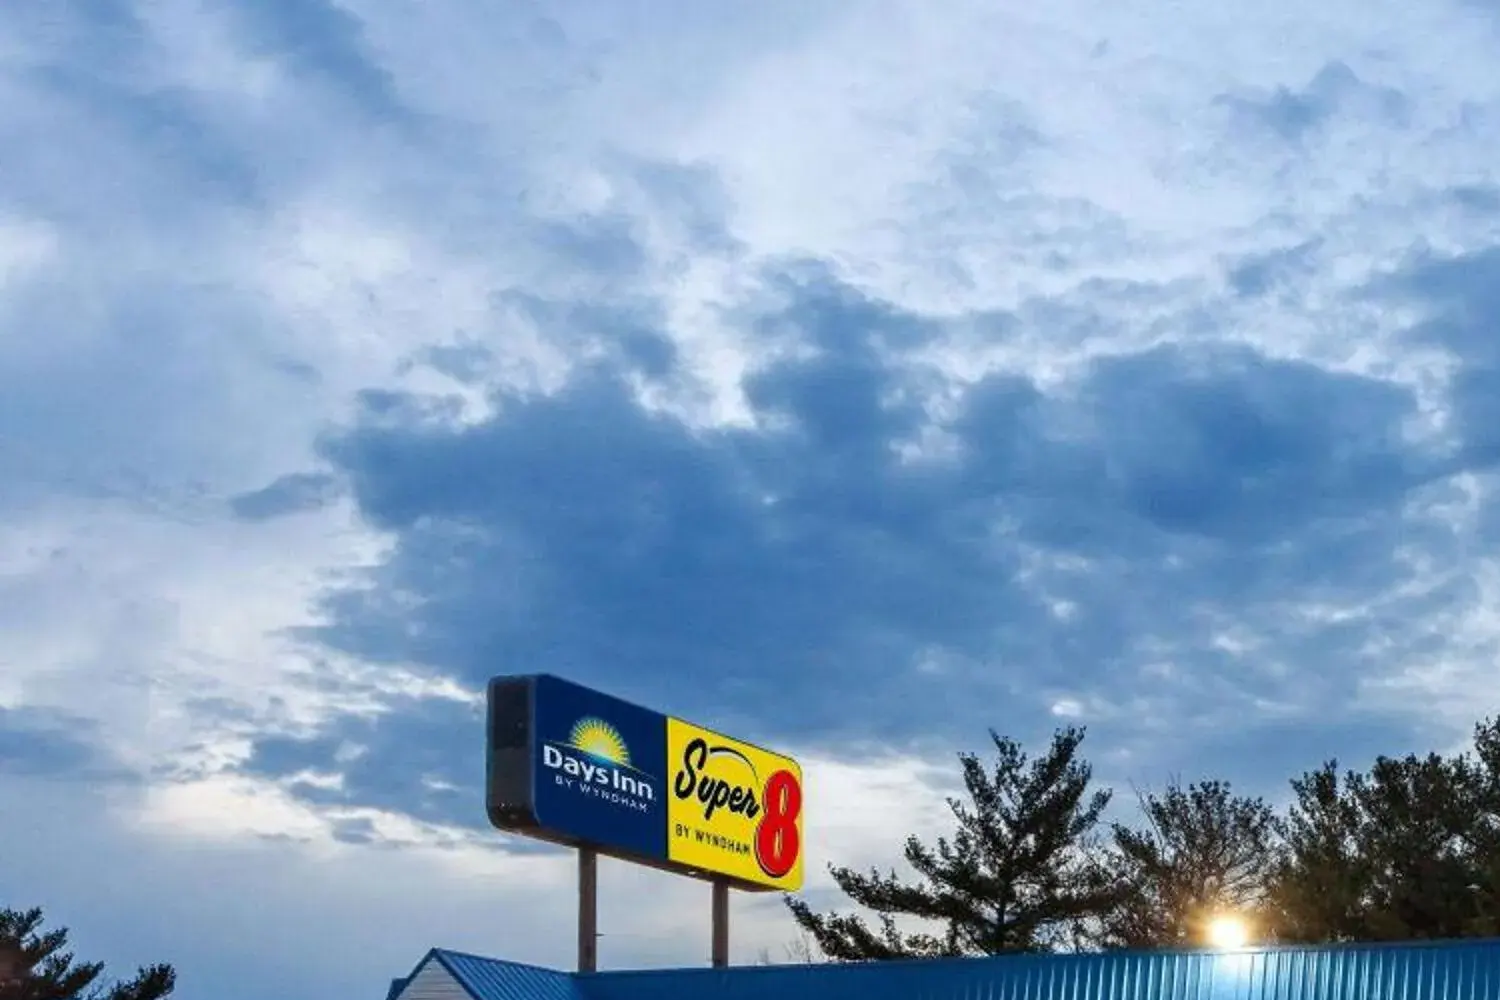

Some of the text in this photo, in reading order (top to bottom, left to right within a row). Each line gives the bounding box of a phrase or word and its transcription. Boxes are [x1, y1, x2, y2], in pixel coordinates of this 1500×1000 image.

[543, 744, 654, 801] Days Inn
[555, 774, 649, 813] BY WYNDHAM
[674, 737, 802, 879] Super 8
[675, 823, 751, 856] BY WYNDHAM
